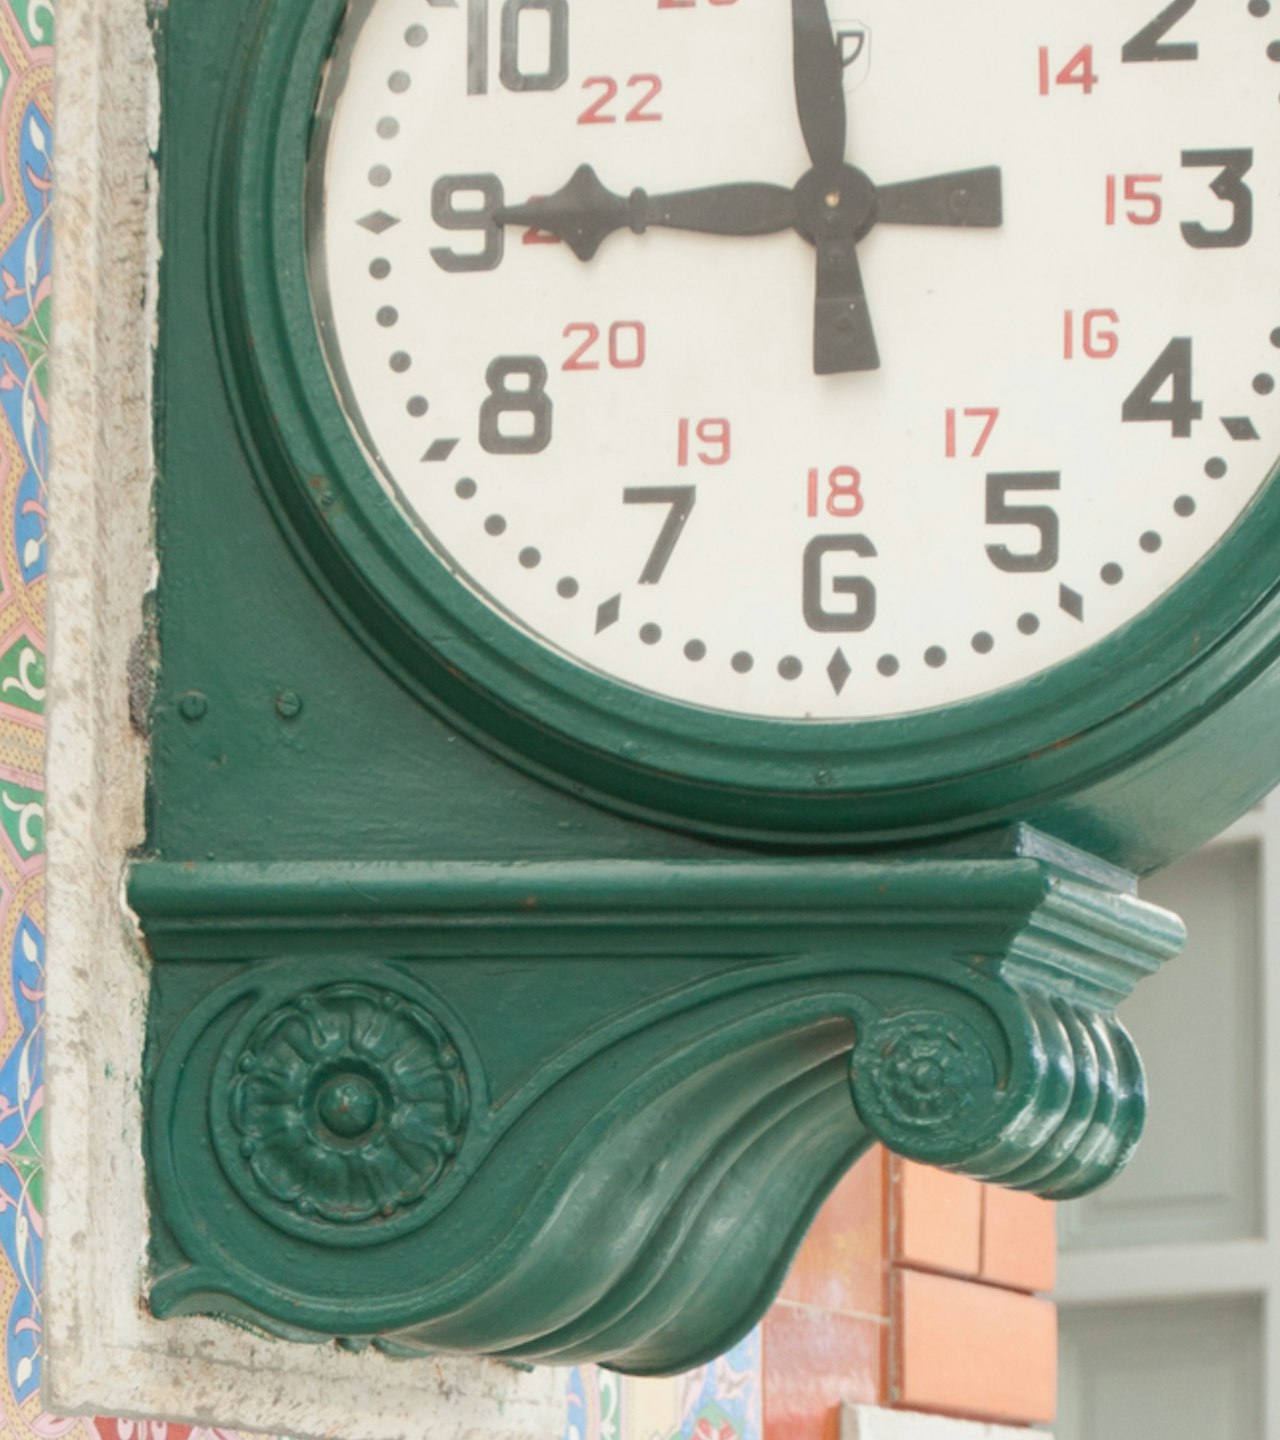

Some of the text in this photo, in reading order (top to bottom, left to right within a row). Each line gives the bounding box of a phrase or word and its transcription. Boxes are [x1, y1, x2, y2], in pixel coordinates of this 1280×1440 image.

[1038, 45, 1098, 96] 14
[577, 74, 663, 124] 22
[430, 172, 505, 273] 9
[1104, 173, 1163, 226] 15
[1180, 147, 1254, 249] 3
[562, 320, 646, 371] 20
[1062, 309, 1119, 360] 16
[478, 356, 553, 454] 8
[1121, 336, 1202, 438] 4
[677, 417, 731, 466] 19
[944, 407, 1000, 458] 17
[806, 465, 864, 518] 18
[623, 485, 697, 584] 7
[984, 471, 1061, 573] 5
[802, 533, 876, 633] 6
